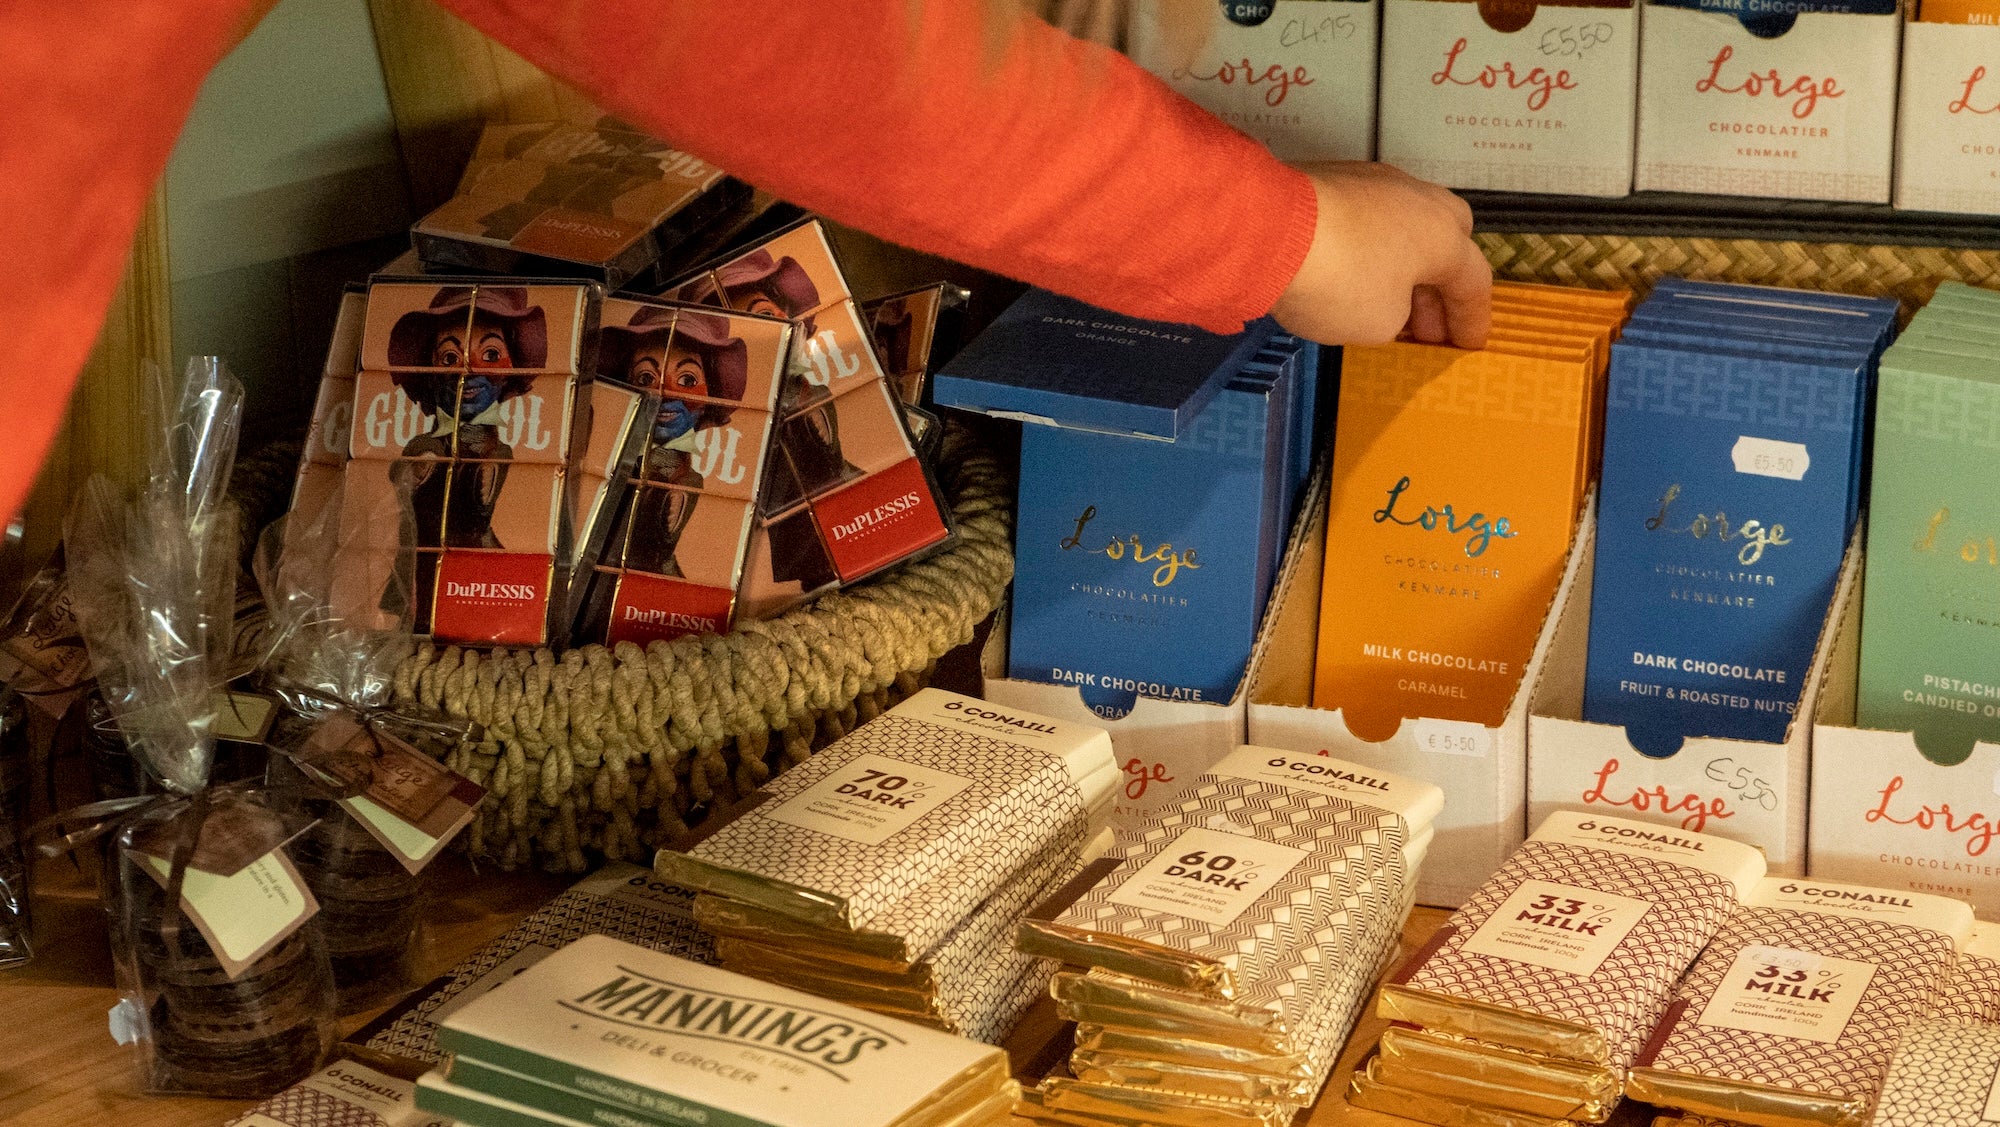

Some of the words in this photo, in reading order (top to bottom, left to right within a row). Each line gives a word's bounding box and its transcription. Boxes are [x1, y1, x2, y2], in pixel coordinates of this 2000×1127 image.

[1968, 13, 2000, 25] MIL
[1431, 37, 1578, 111] Lorge
[1695, 45, 1846, 119] Lorge
[1445, 115, 1563, 129] CHOCOLATIER
[1709, 122, 1829, 138] CHOCOLATIER
[1737, 148, 1798, 159] KENMARE
[1042, 316, 1087, 327] DARK
[1091, 322, 1194, 344] CHOCOLATE
[1075, 332, 1138, 346] ORANGE
[831, 491, 920, 541] DuPLESSIS
[1373, 476, 1519, 558] Lorge
[1644, 483, 1793, 566] Lorge
[1060, 505, 1206, 587] Lorge
[1384, 554, 1500, 579] CHOCOLATIER
[446, 581, 535, 600] DuPLESSIS
[1071, 582, 1188, 608] CHOCOLATIER
[1399, 581, 1480, 600] KENMARE
[1670, 590, 1755, 608] KENMARE
[625, 605, 716, 632] DuPLESSIS
[1363, 643, 1402, 660] MILK
[1407, 650, 1509, 675] CHOCOLATE
[1633, 652, 1677, 670] DARK
[1682, 659, 1786, 683] CHOCOLATE
[1052, 668, 1096, 686] DARK
[1101, 676, 1202, 701] CHOCOLATE
[1397, 679, 1467, 700] CARAMEL
[1620, 680, 1662, 697] FRUIT
[1666, 687, 1676, 699] &
[1680, 689, 1749, 708] ROASTED
[1754, 699, 1796, 714] NUTS
[1924, 674, 2000, 699] PISTACHI
[1903, 689, 1978, 714] CANDIED
[964, 707, 1056, 734] CONAILL
[1428, 734, 1437, 749] €
[852, 769, 936, 798] 70%
[1268, 757, 1286, 767] Ó
[1290, 762, 1389, 791] CONAILL
[1271, 773, 1364, 793] chocolate
[834, 784, 915, 809] DARK
[1582, 758, 1735, 832] Lorge
[805, 806, 851, 820] handmade
[813, 801, 840, 811] CORK
[847, 809, 886, 822] IRELAND
[1865, 776, 2000, 857] Lorg
[1578, 820, 1596, 830] Ó
[1600, 825, 1704, 851] CONAILL
[1584, 838, 1679, 853] chocolate
[1179, 851, 1258, 879] 60%
[1163, 865, 1249, 891] DARK
[1909, 881, 1972, 896] KENMARE
[1140, 891, 1195, 906] handmade
[1146, 885, 1176, 894] CORK
[1182, 892, 1227, 905] IRELAND
[1779, 884, 1798, 893] Ó
[1803, 888, 1913, 908] CONAILL
[1789, 898, 1889, 913] chocolate
[1530, 894, 1617, 923] 33%
[1515, 910, 1604, 936] MILK
[1496, 937, 1549, 951] handmade
[1554, 949, 1578, 959] 100g
[1501, 931, 1532, 940] CORK
[1539, 938, 1585, 951] IRELAND
[1755, 964, 1843, 988] 33%
[1745, 978, 1835, 1003] MILK
[576, 975, 888, 1065] MANNING'S
[1731, 1008, 1787, 1020] handmade
[1793, 1017, 1818, 1027] 100g
[1734, 1001, 1767, 1010] CORK
[1774, 1007, 1823, 1019] IRELAND
[600, 1031, 649, 1052] DELI
[649, 1046, 666, 1058] &
[670, 1051, 760, 1083] GROCER
[340, 1074, 403, 1102] CONAILL
